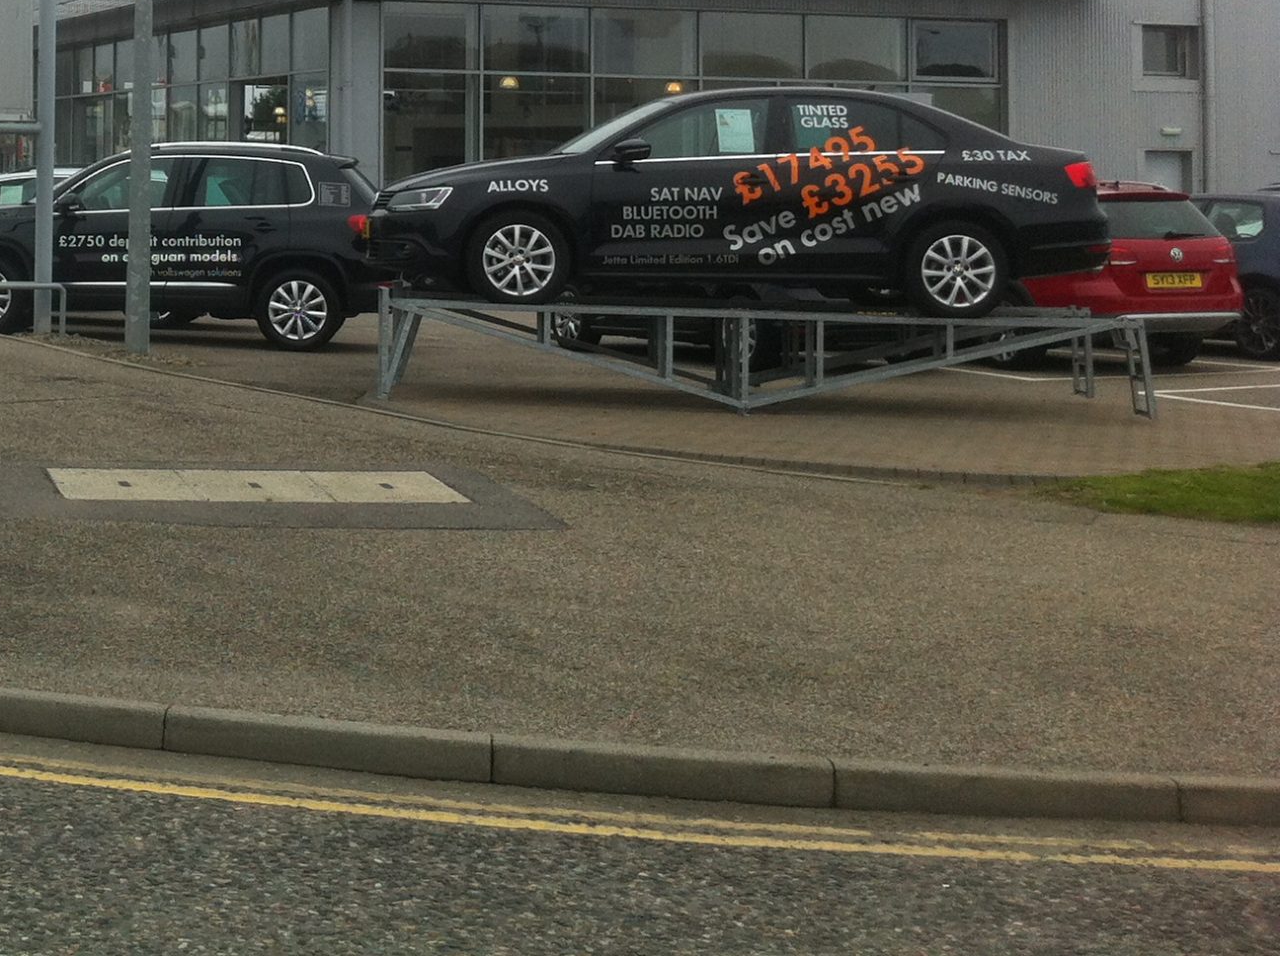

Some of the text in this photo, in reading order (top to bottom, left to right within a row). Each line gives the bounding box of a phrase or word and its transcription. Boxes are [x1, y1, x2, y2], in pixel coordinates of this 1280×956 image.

[796, 104, 848, 116] TINTED
[800, 116, 849, 129] GLASS
[961, 150, 1031, 161] £30 TAX
[733, 125, 876, 205] £17495
[487, 179, 549, 193] ALLOYS
[937, 172, 1058, 204] PARKING SENSORS
[650, 187, 723, 202] SAT NAV
[723, 147, 925, 251] Save £3255
[622, 205, 718, 220] BLUETOOTH
[611, 224, 704, 238] DAB RADIO
[757, 184, 921, 265] on cost new
[58, 235, 105, 247] £2750
[162, 234, 242, 247] contribution
[101, 253, 118, 262] on
[602, 255, 628, 265] Jetta
[630, 254, 666, 265] Limited
[669, 254, 704, 264] Edition
